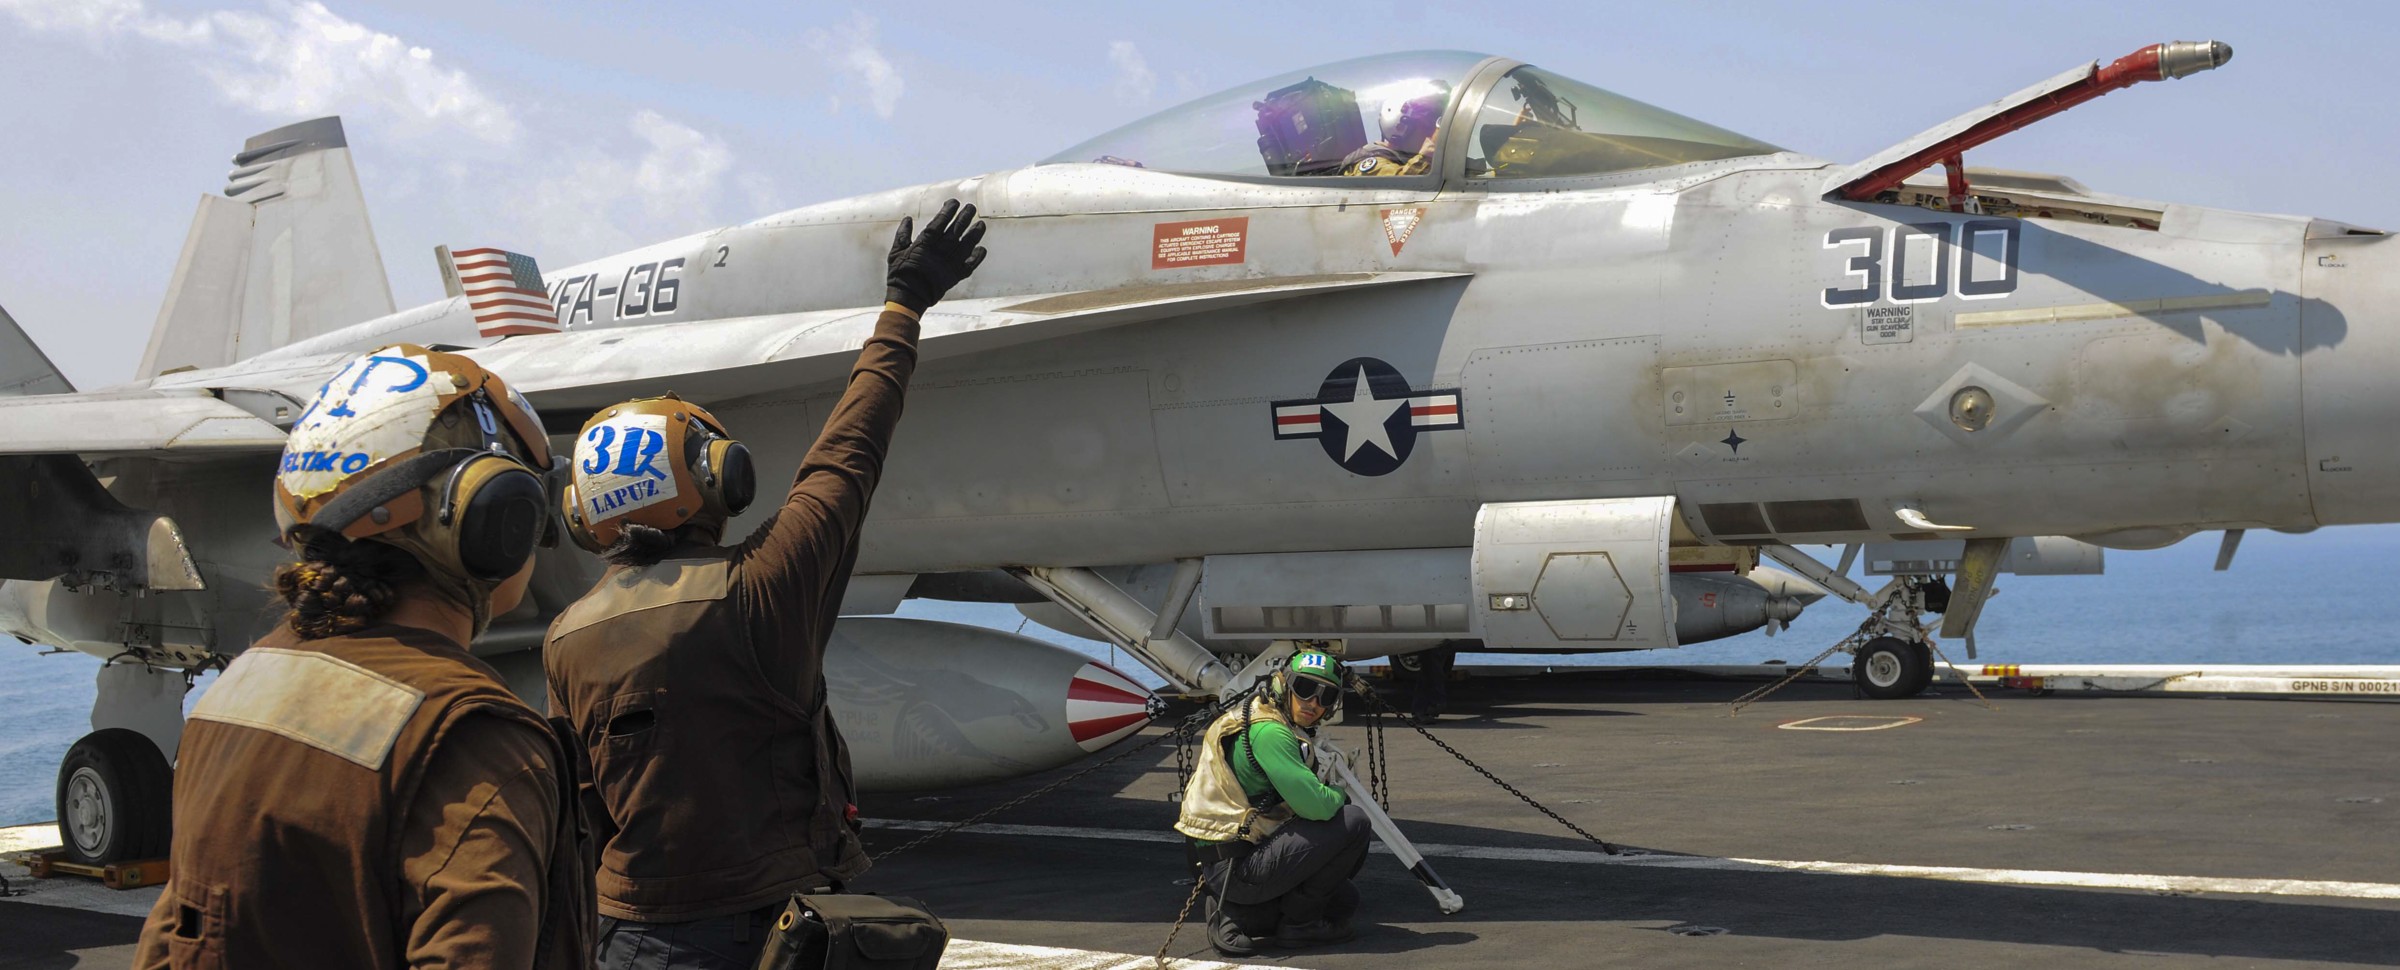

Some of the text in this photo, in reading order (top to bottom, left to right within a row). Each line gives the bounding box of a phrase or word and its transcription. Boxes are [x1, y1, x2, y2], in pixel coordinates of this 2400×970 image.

[1182, 225, 1219, 236] WARNING
[713, 245, 730, 268] 2
[1820, 219, 2021, 310] 300
[1866, 306, 1911, 318] WARNING
[1880, 323, 1910, 331] SCAVENGE
[591, 477, 660, 515] LAPUZ
[2291, 680, 2400, 692] GPNB S/N 00021
